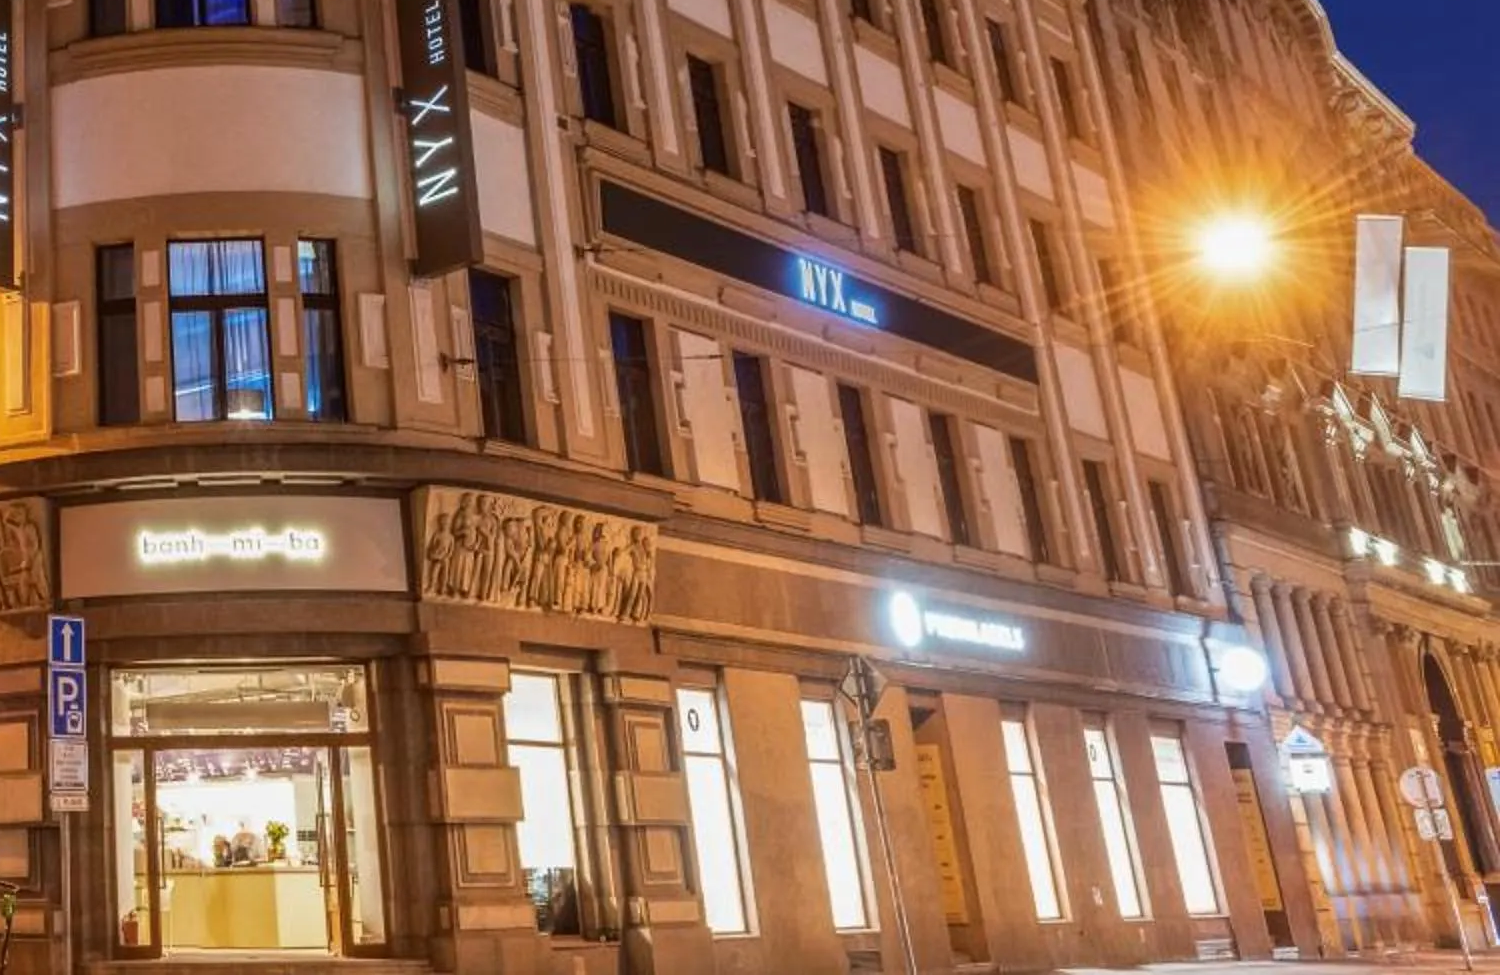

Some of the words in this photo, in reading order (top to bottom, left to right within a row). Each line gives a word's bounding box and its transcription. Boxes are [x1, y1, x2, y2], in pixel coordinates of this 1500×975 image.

[410, 85, 460, 206] NYX
[798, 257, 847, 313] NYX
[57, 676, 80, 716] P
